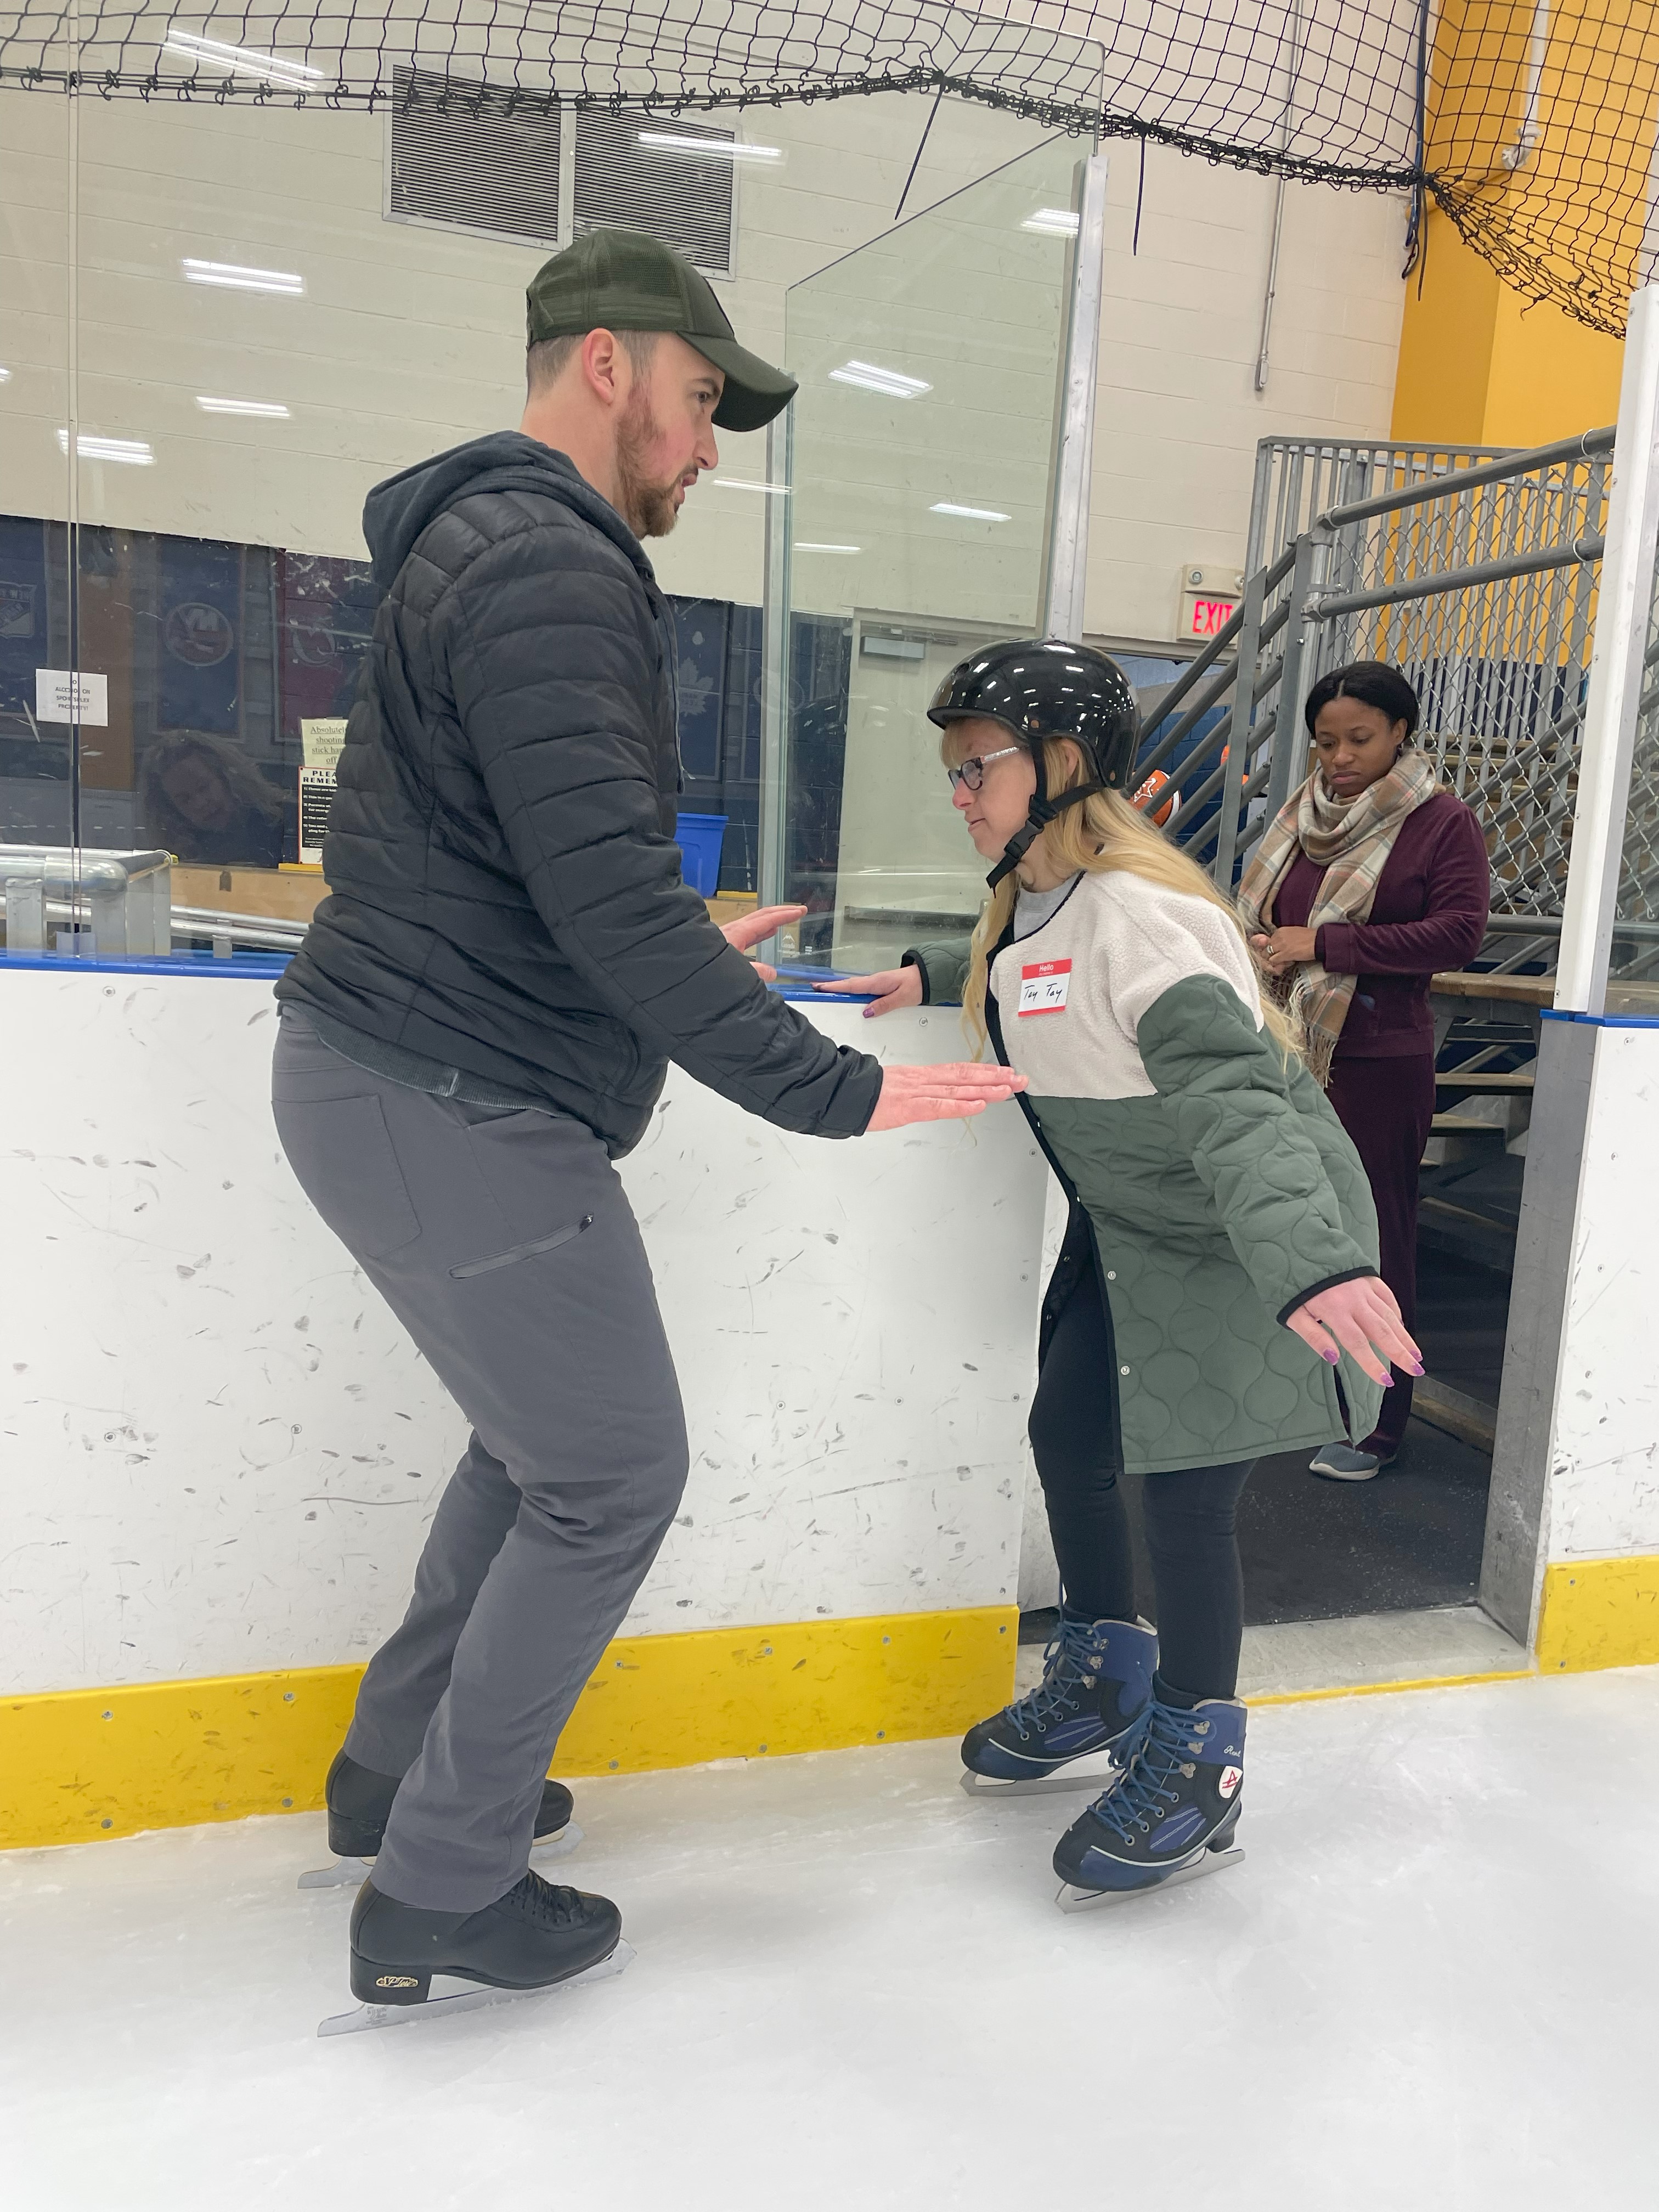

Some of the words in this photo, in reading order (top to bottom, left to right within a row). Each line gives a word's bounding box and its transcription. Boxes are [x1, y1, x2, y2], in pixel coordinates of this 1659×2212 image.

[1192, 600, 1233, 635] EXIT
[1039, 963, 1054, 973] Hello
[1024, 985, 1038, 1002] Tay
[1046, 983, 1063, 1003] Tay
